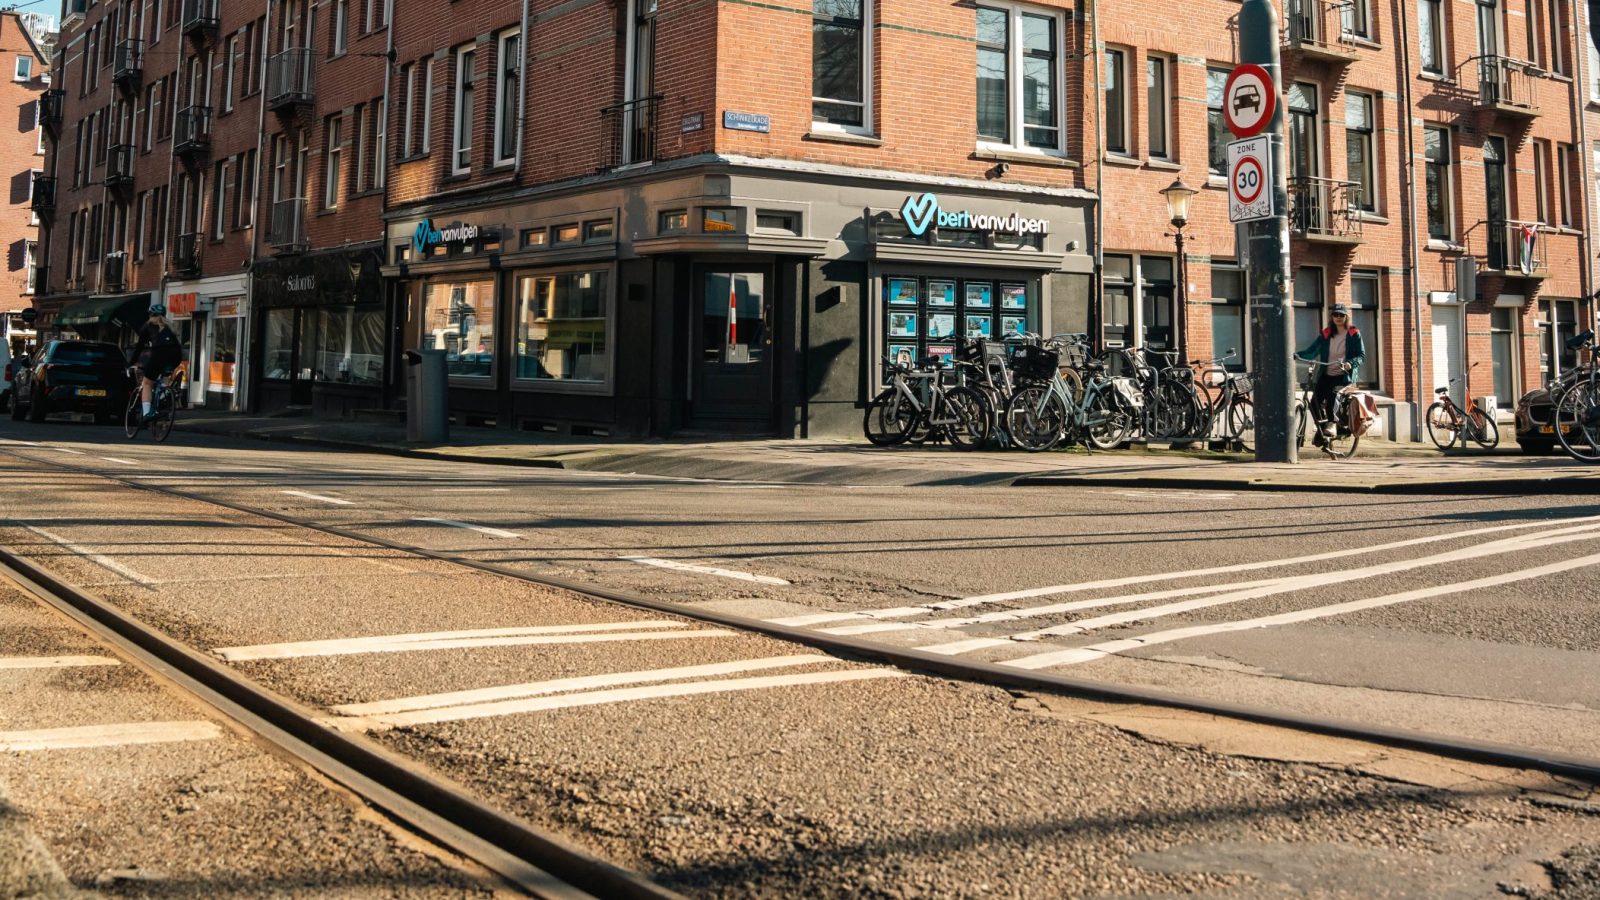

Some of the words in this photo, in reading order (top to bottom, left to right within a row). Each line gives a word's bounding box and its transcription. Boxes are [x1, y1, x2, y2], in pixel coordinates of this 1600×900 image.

[1236, 143, 1256, 154] ZONE
[1238, 170, 1258, 189] 30
[937, 206, 1048, 236] bertvanvulpen
[427, 223, 478, 244] bertvanvulpen
